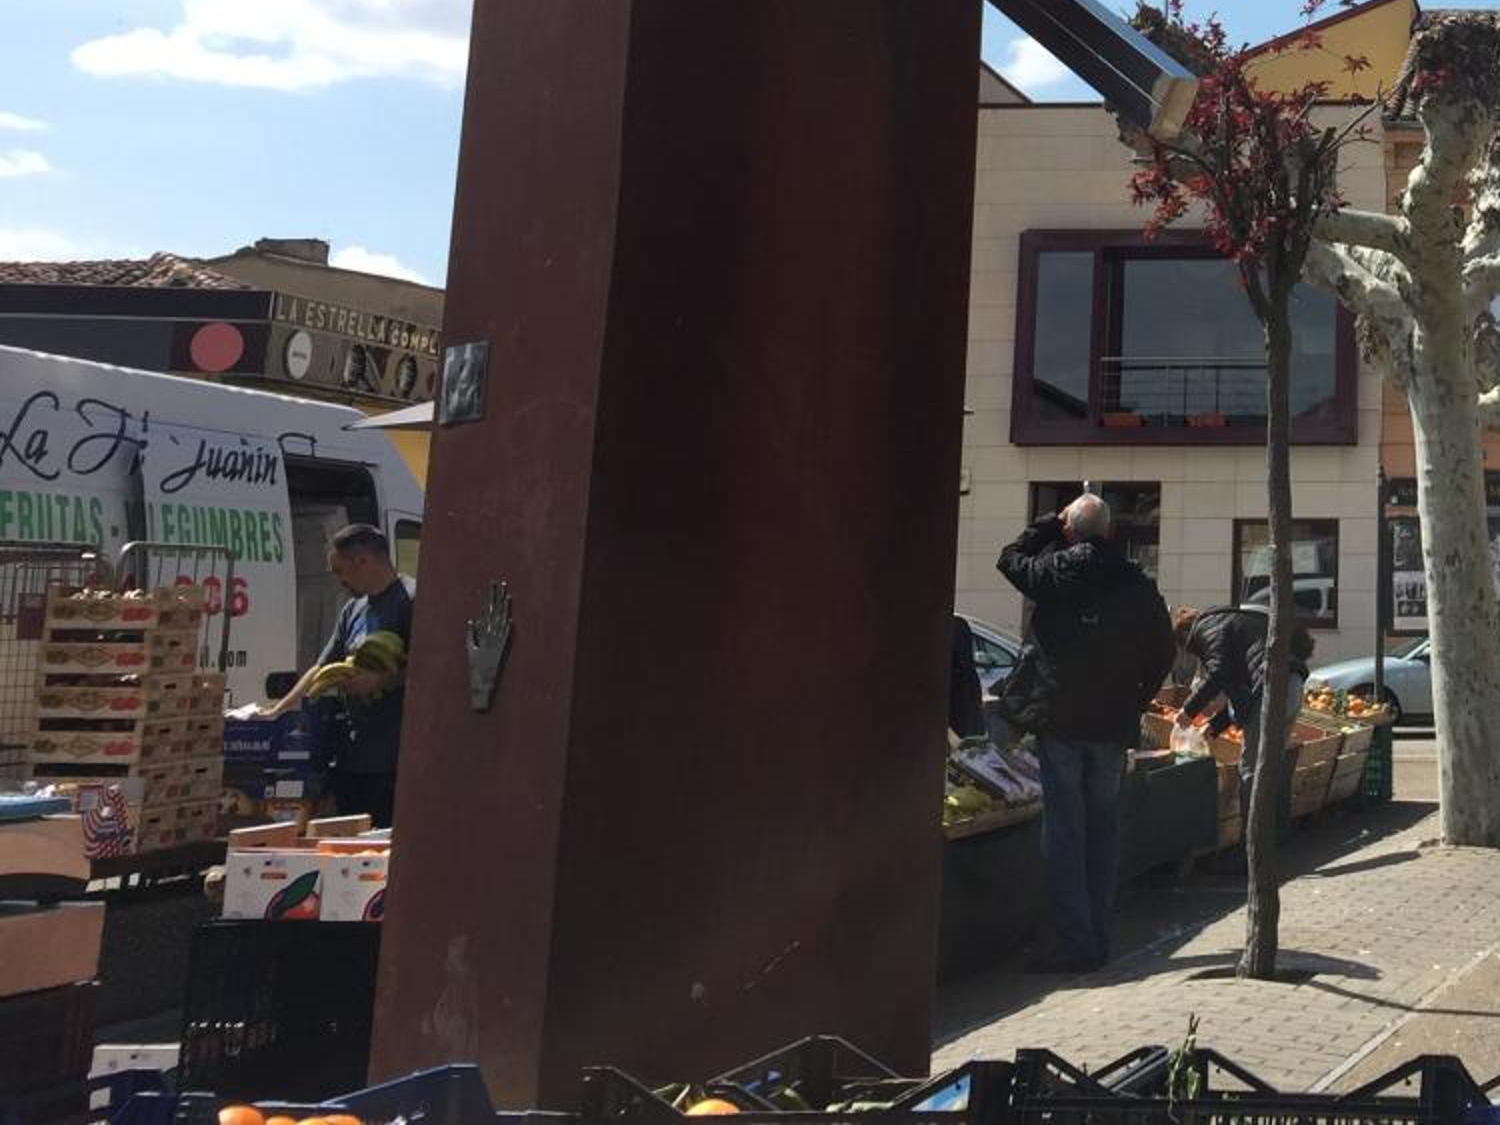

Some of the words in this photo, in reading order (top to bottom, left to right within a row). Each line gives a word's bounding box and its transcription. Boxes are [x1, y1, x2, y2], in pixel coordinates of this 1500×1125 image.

[275, 294, 298, 323] LA
[304, 301, 386, 342] ESTRELLA
[391, 323, 442, 354] COMPL
[0, 488, 103, 545] FRUTAS
[148, 500, 284, 564] LEGUMBRES
